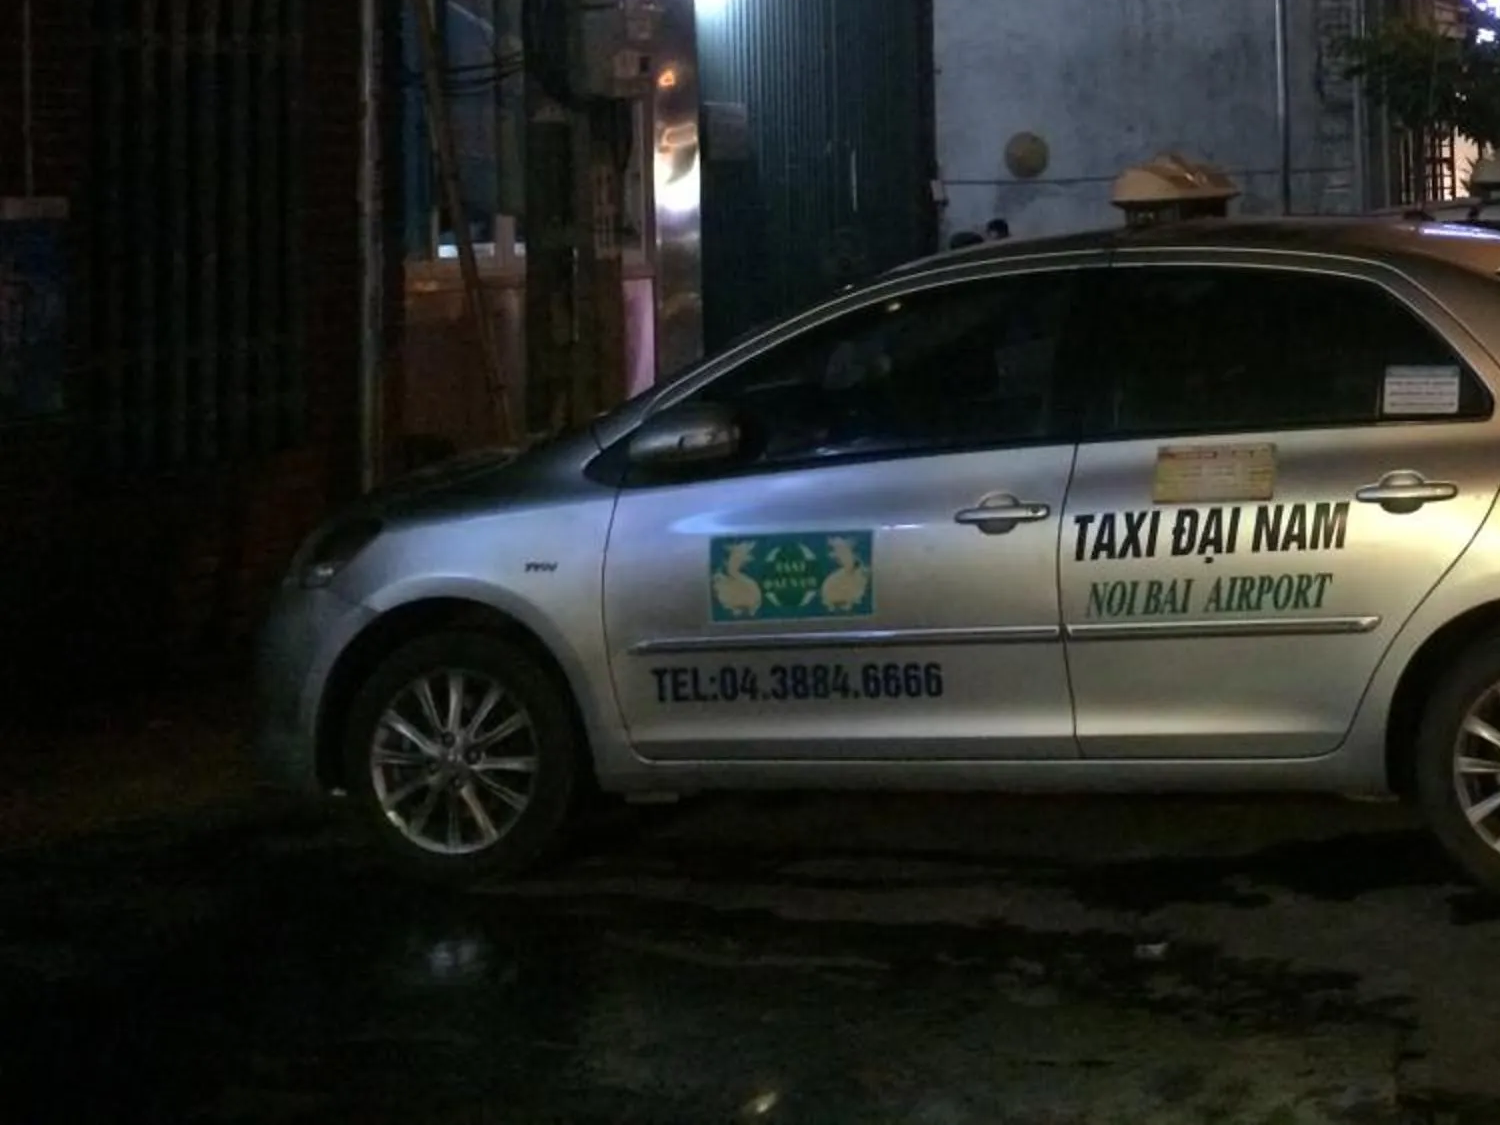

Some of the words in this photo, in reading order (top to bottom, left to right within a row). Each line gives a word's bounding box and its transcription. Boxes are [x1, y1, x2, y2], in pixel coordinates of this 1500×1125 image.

[1074, 509, 1161, 562] TAXI
[1170, 505, 1242, 565] ĐẠI
[1251, 501, 1351, 553] NAM
[1203, 572, 1334, 614] AIRPORT
[650, 662, 944, 704] TEL:04.3884.6666
